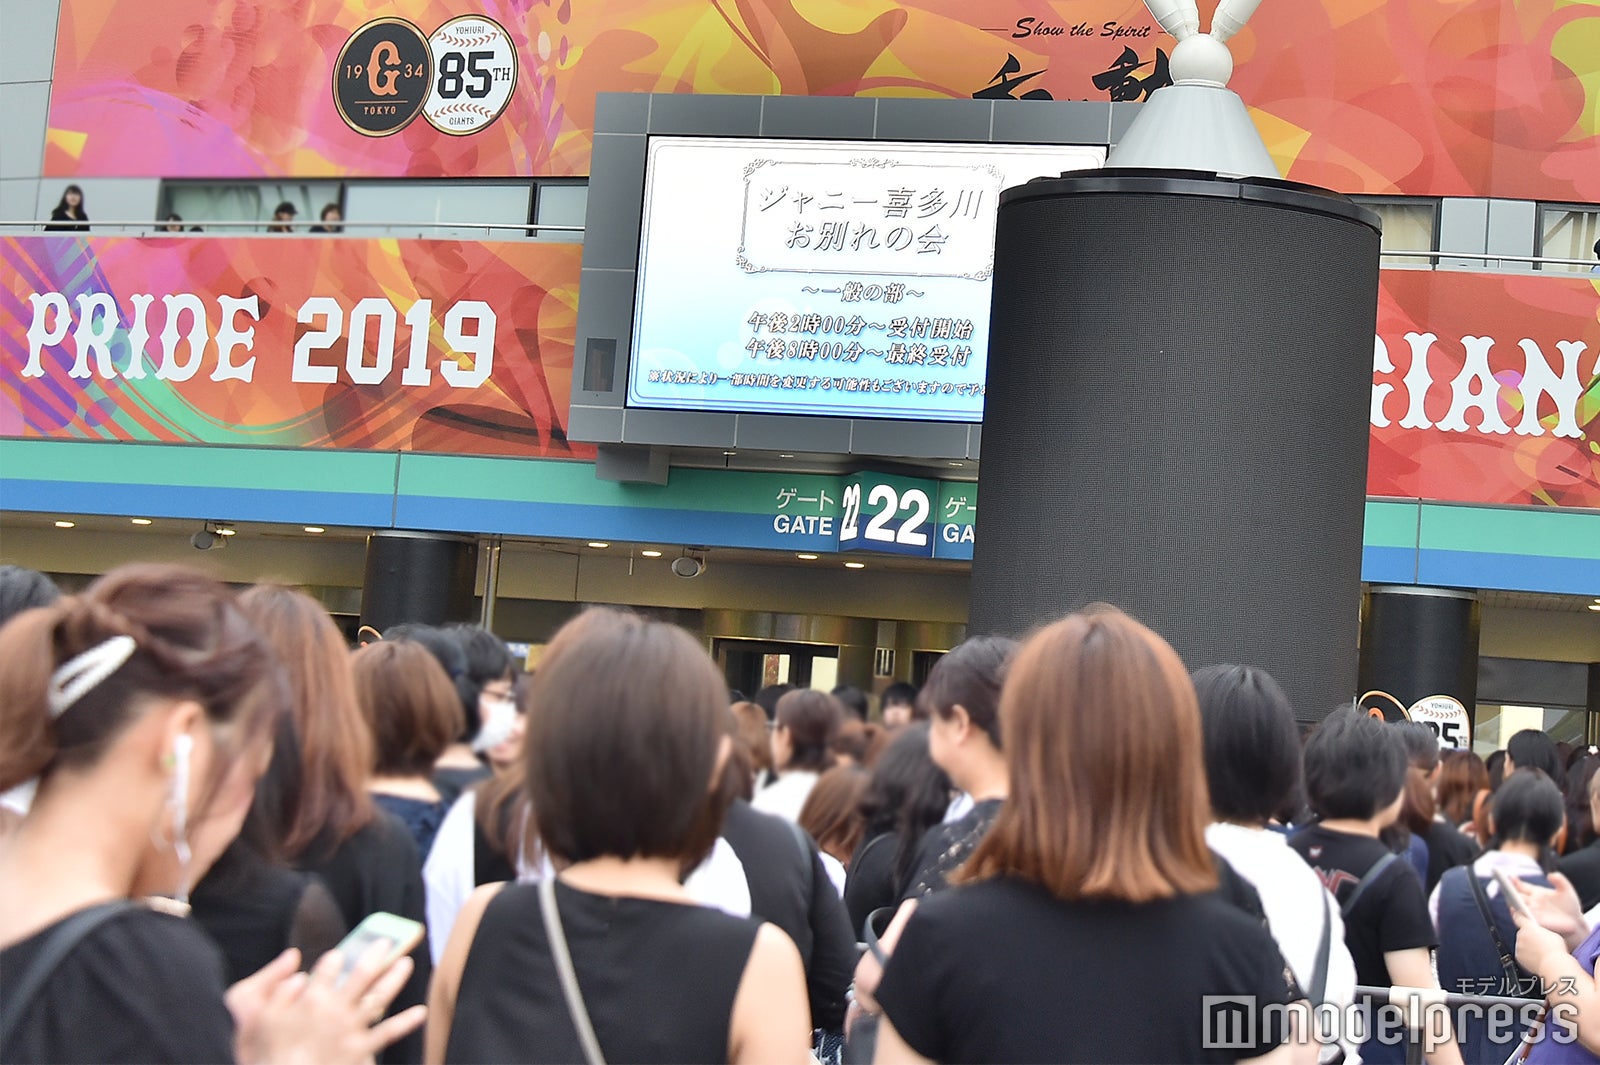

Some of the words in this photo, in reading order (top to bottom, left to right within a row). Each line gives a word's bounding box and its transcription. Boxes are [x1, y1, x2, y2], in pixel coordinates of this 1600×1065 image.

[1012, 17, 1065, 38] Show
[1070, 21, 1094, 37] the
[1100, 21, 1151, 41] Spirit
[366, 40, 402, 97] G
[364, 106, 397, 115] TOKYO
[449, 116, 475, 126] GIANTS
[759, 185, 984, 219] ジャニー喜多川
[786, 220, 949, 254] お別れの会
[20, 291, 260, 384] PRIDE
[291, 296, 498, 388] 2019
[1370, 331, 1600, 438] IAN
[776, 487, 834, 511] ゲート
[839, 482, 861, 542] 22
[864, 484, 930, 547] 22
[773, 514, 833, 536] GATE
